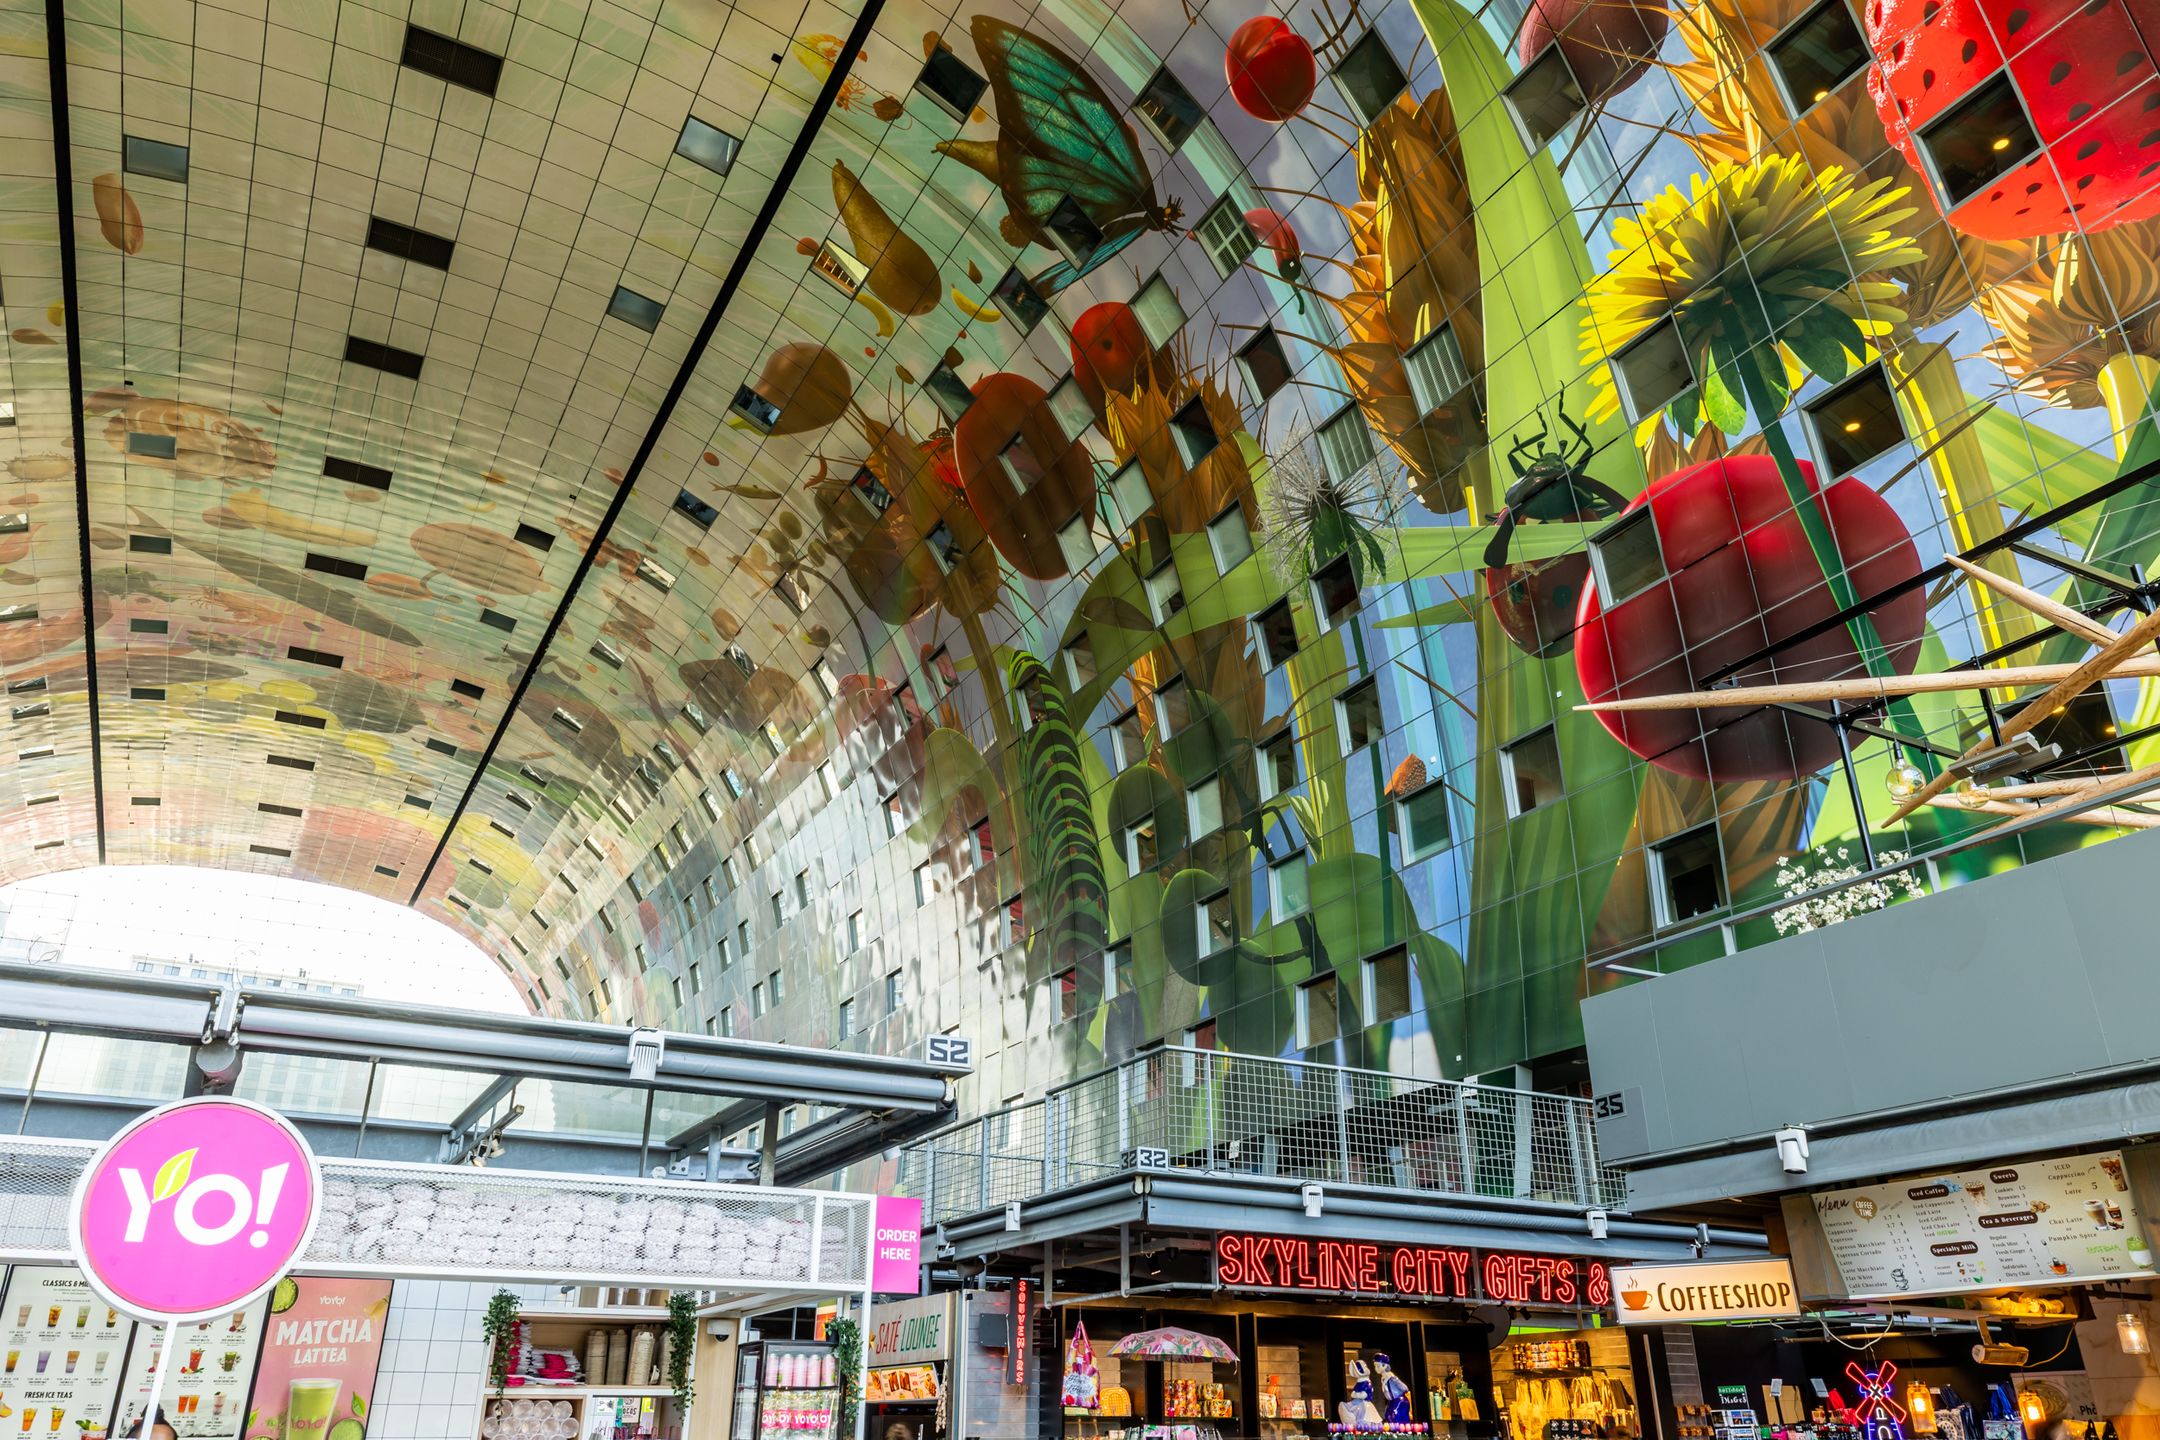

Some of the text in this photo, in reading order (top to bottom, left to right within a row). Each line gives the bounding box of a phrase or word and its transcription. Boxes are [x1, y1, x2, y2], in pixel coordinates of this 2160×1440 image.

[930, 1038, 968, 1064] 52
[1595, 1093, 1624, 1118] 35
[1121, 1150, 1137, 1170] 32
[1140, 1149, 1166, 1168] 32
[2048, 1172, 2086, 1180] Cappuccino
[1924, 1188, 1946, 1196] Coffee
[2092, 1182, 2098, 1190] 5
[118, 1162, 290, 1248] YO!
[1855, 1200, 1873, 1210] COFFEE
[1860, 1209, 1872, 1217] TIME
[2131, 1208, 2138, 1217] 5
[2000, 1214, 2034, 1223] Beverages
[877, 1228, 917, 1242] ORDER
[880, 1247, 912, 1260] HERE
[1932, 1246, 1960, 1254] Specialty
[1219, 1236, 1609, 1306] SKYLINE CITY GIFTS &
[1657, 1282, 1790, 1312] COFFEESHOP
[276, 1319, 372, 1346] MATCHA
[876, 1314, 942, 1354] SATÉ LOUNGE
[1016, 1280, 1026, 1384] SOUVENIRS
[294, 1347, 347, 1364] LATTEA
